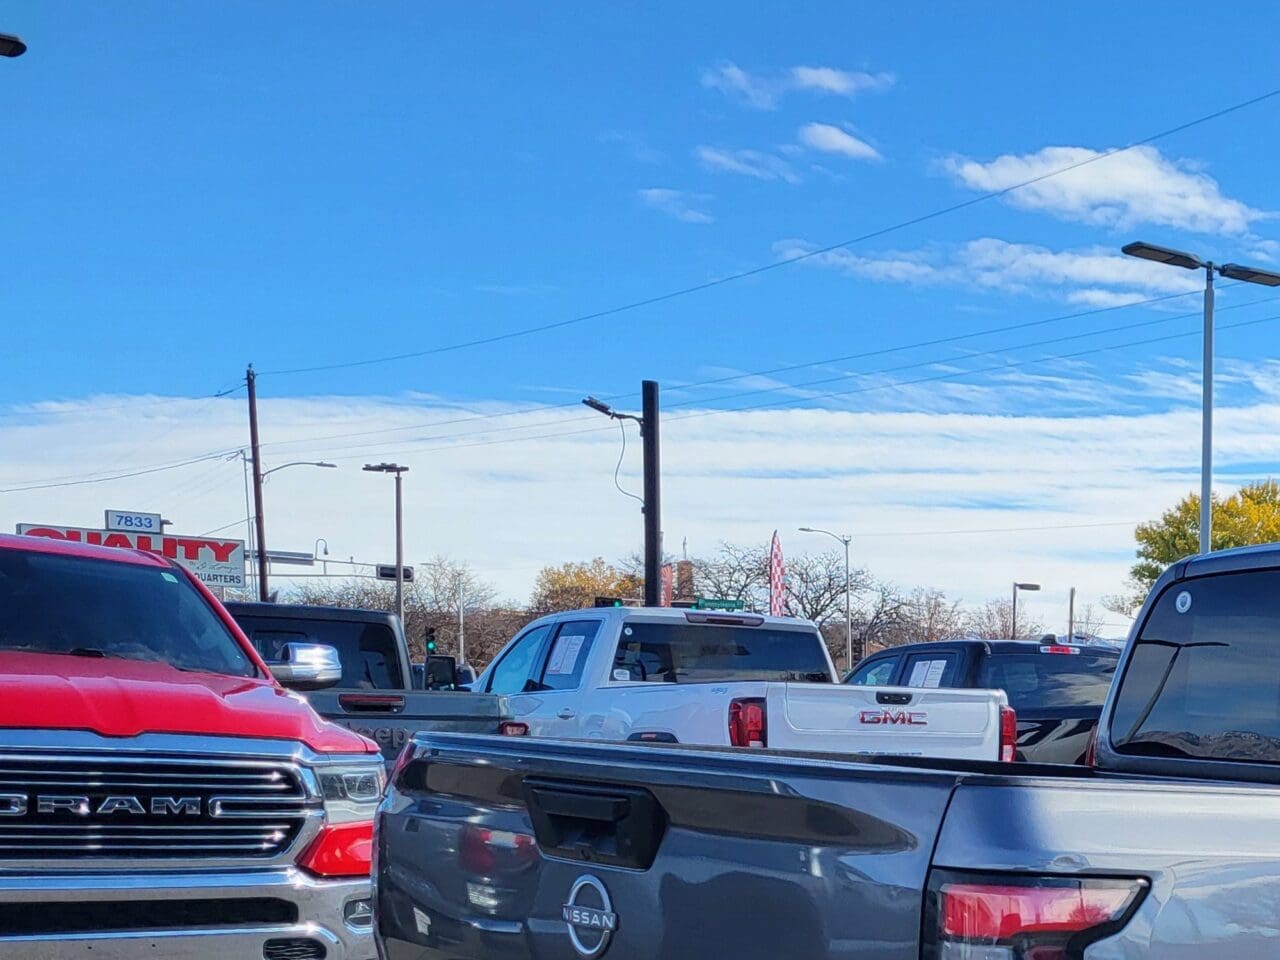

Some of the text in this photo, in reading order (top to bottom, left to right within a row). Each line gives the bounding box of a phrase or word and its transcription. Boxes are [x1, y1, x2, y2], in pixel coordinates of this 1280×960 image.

[115, 514, 153, 529] 7833
[859, 710, 928, 725] GMC
[347, 722, 409, 749] eep
[37, 794, 202, 816] RAM
[562, 906, 614, 929] NISSAN
